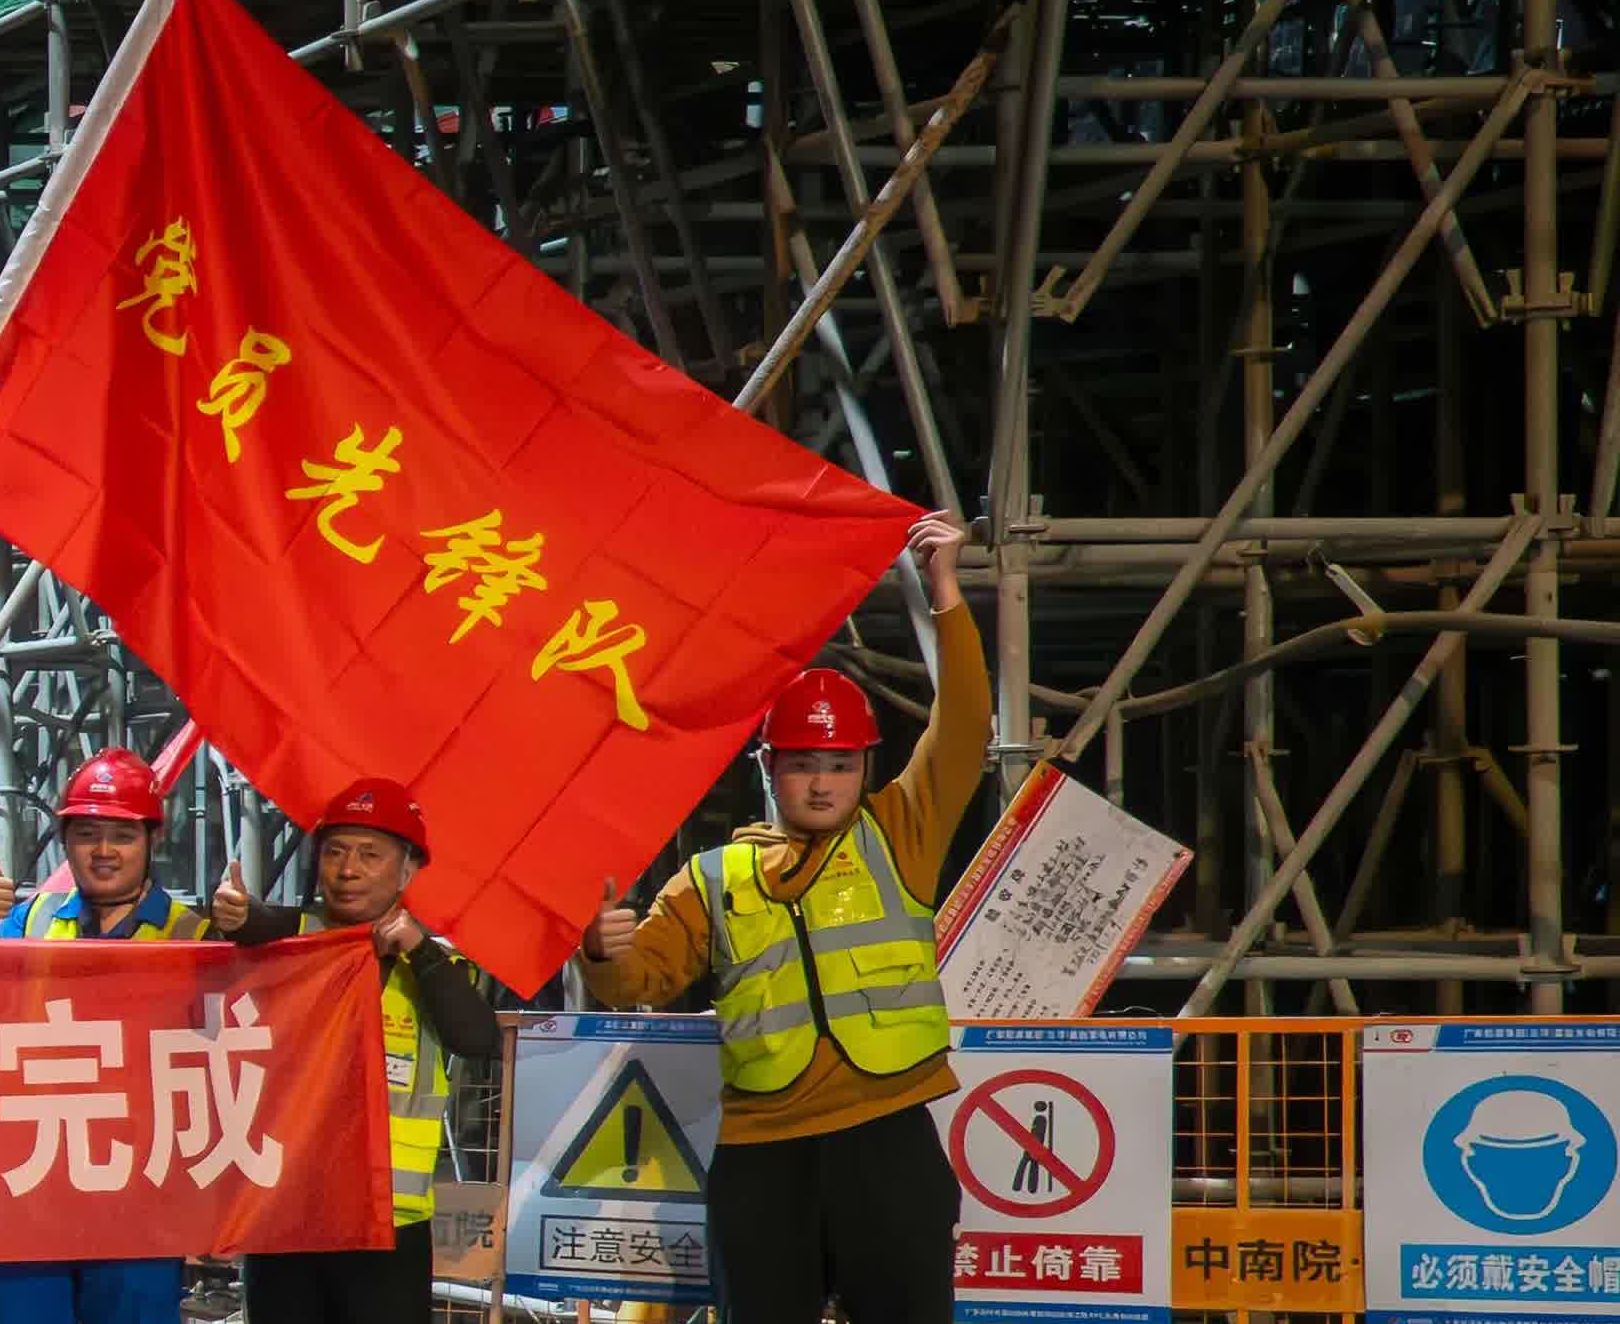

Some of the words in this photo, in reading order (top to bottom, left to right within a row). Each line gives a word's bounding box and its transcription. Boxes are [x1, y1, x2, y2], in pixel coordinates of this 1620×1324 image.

[115, 215, 652, 733] 党员先锋队
[551, 1226, 704, 1270] 注意安全
[1411, 1252, 1620, 1296] 必须戴安全帽
